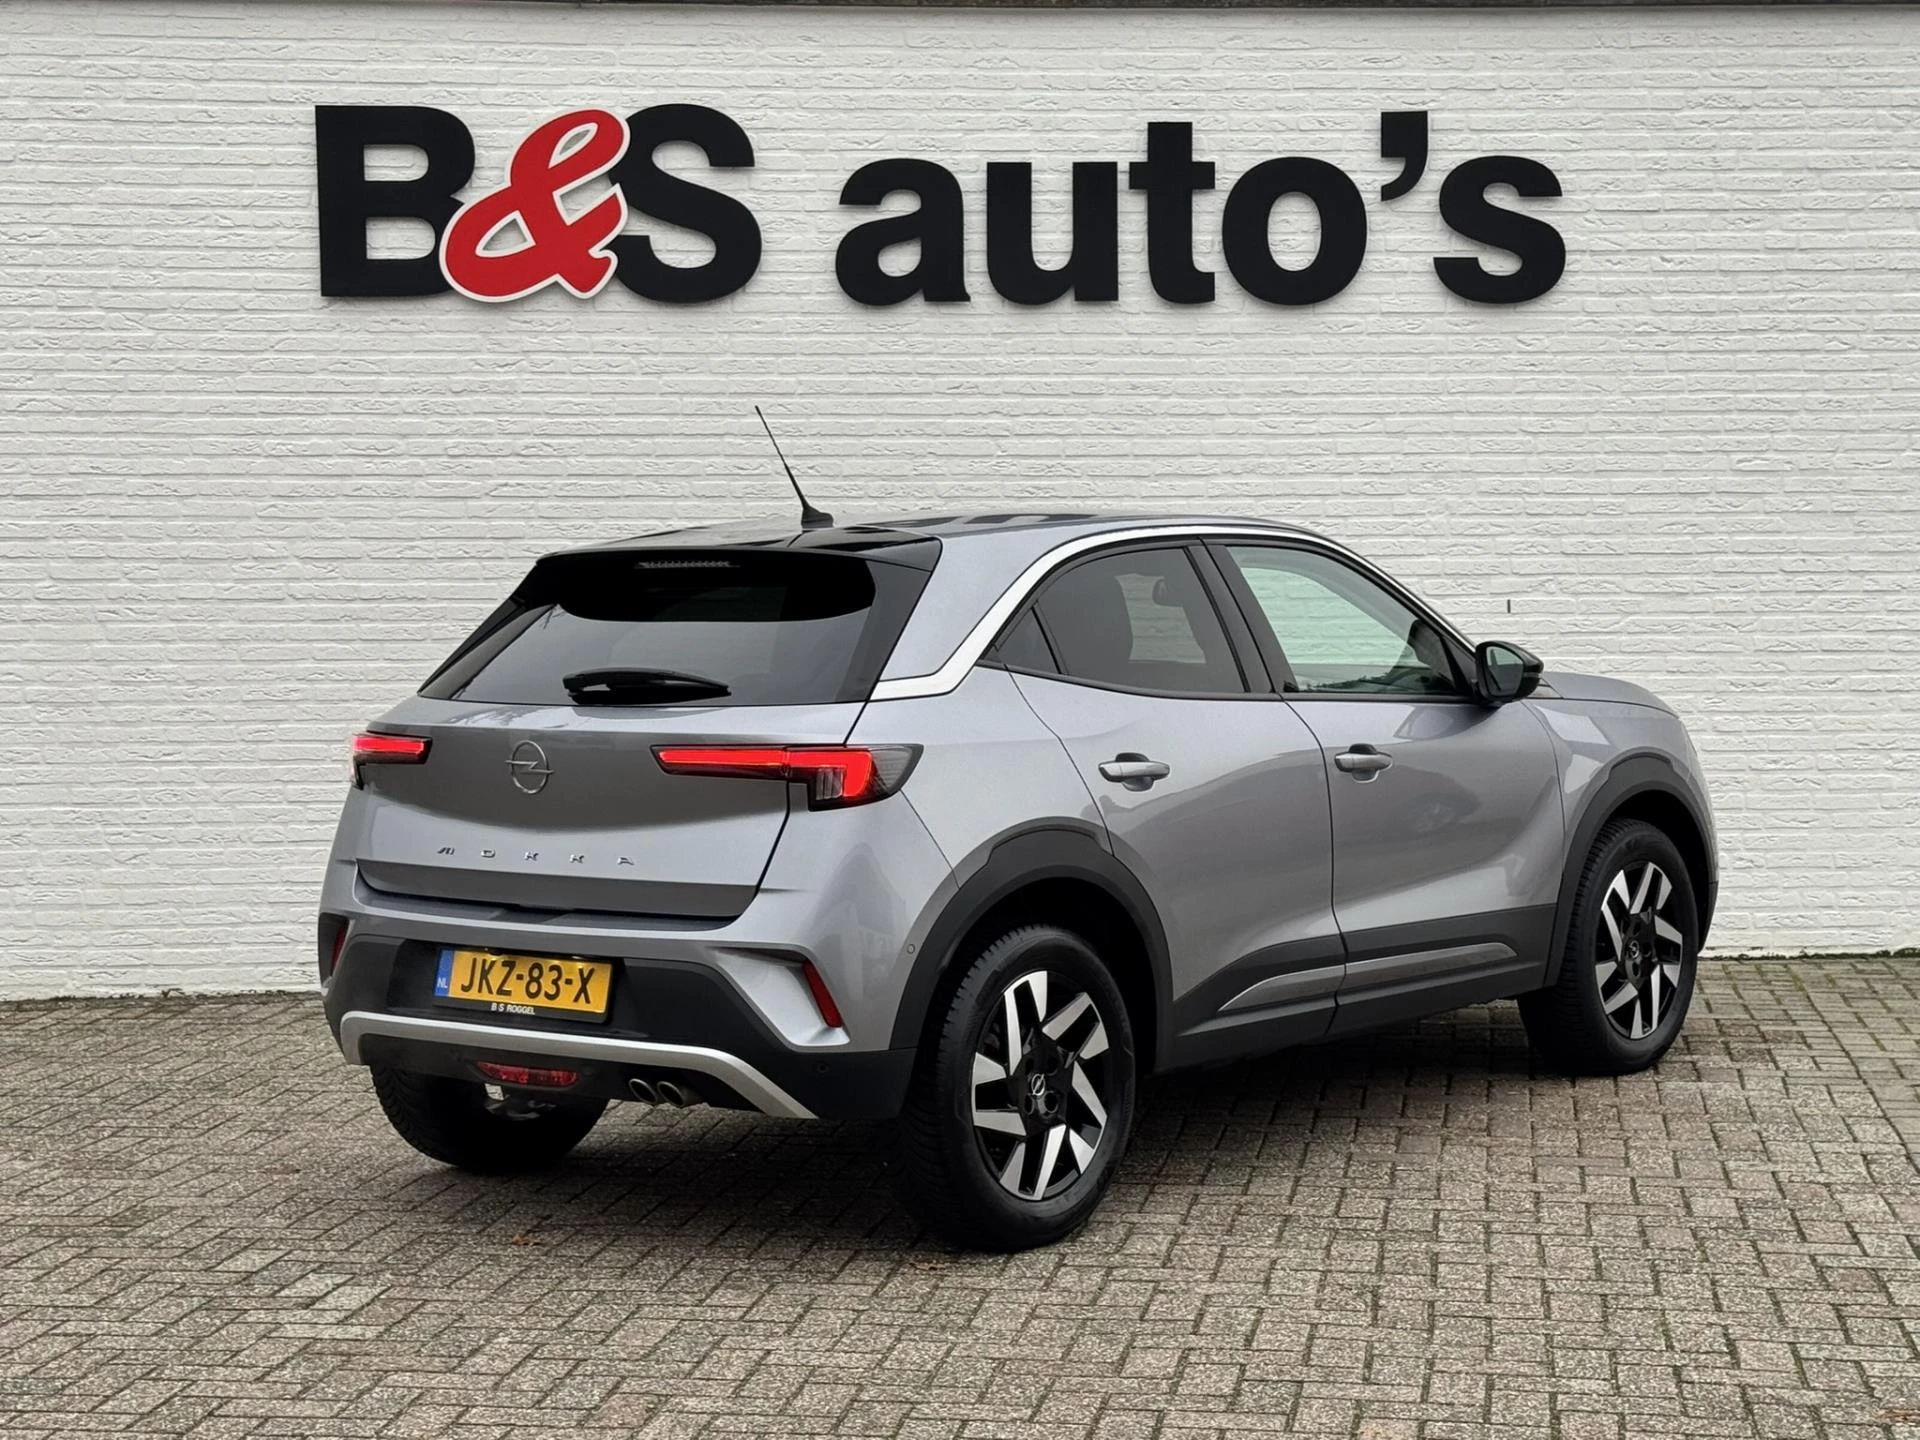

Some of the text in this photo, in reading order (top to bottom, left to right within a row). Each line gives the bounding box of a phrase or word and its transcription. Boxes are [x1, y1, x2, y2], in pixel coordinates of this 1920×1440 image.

[316, 104, 1566, 306] B&S auto's
[437, 976, 448, 989] NL
[461, 957, 595, 1004] JKZ-83-X
[506, 1004, 536, 1016] ROGGEL
